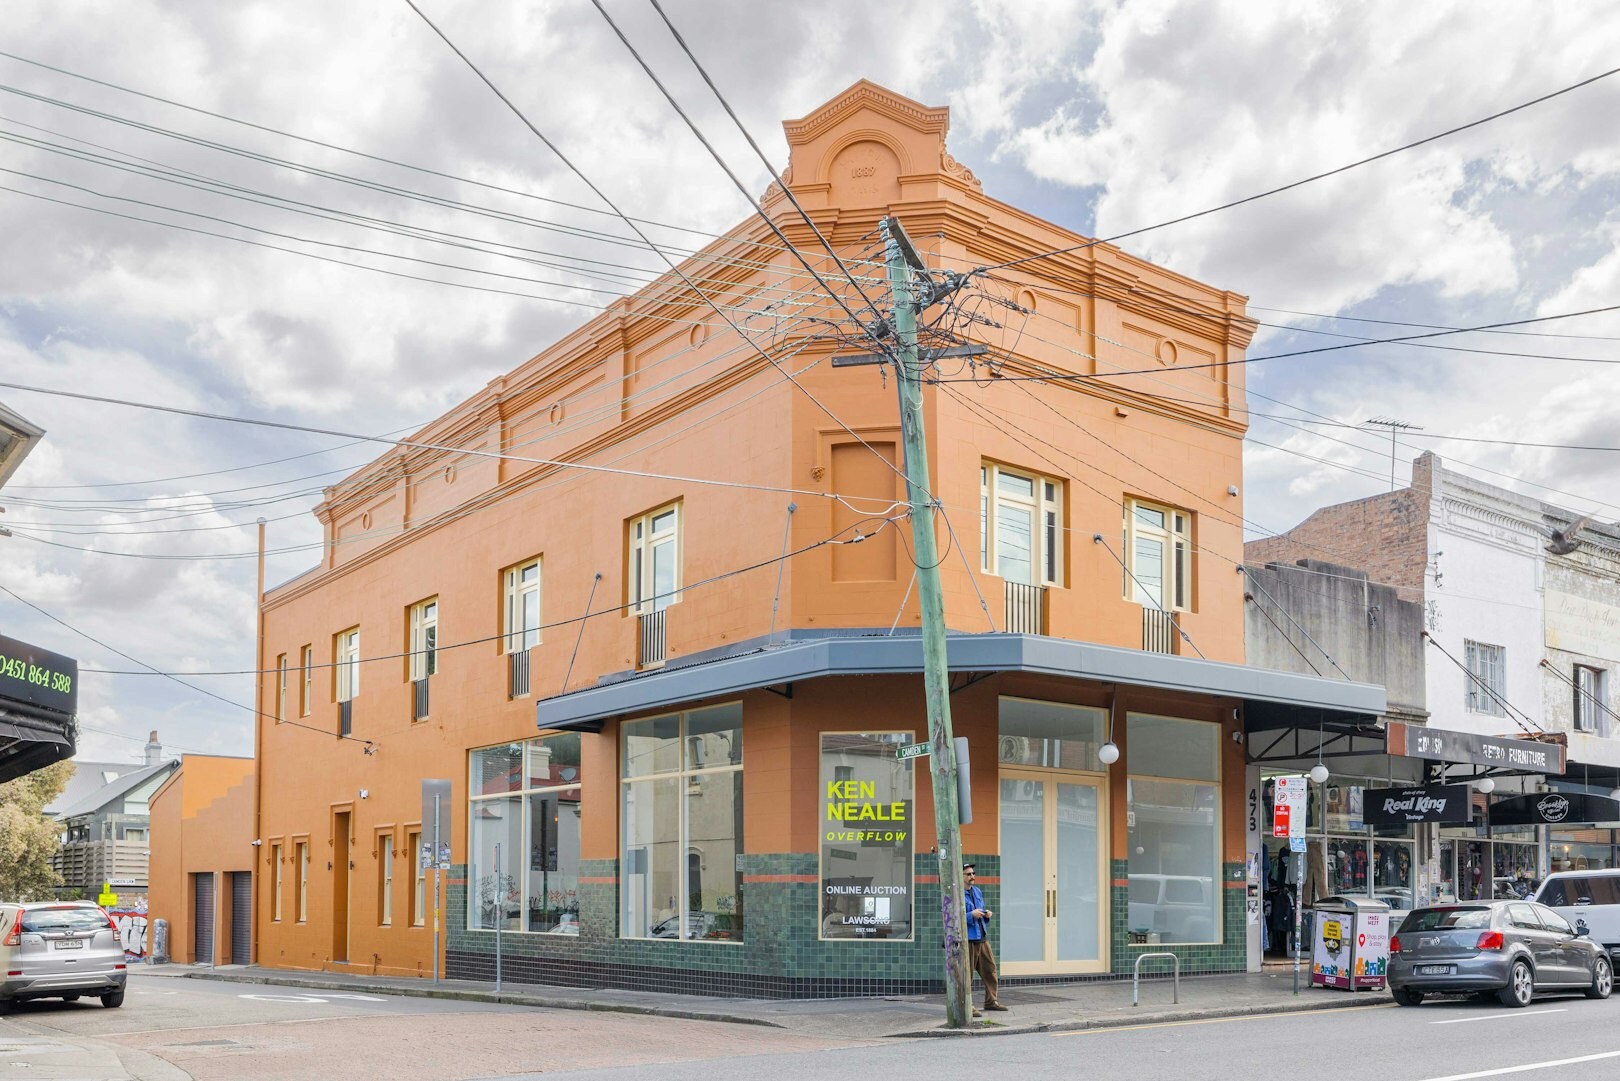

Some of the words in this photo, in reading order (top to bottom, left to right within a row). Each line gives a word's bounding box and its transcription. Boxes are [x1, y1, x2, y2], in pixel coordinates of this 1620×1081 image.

[28, 664, 50, 687] 864
[51, 671, 71, 693] 588
[901, 745, 921, 758] CAMDEN
[1508, 748, 1546, 767] FURNITURE
[827, 780, 876, 799] KEN
[827, 802, 906, 821] NEALE
[1249, 788, 1257, 832] 473
[1382, 797, 1415, 814] Real
[1414, 796, 1447, 814] King
[826, 831, 907, 841] OVERFLOW
[826, 885, 862, 895] ONLINE
[863, 885, 907, 895] AUCTION
[842, 916, 890, 925] LAWSONS
